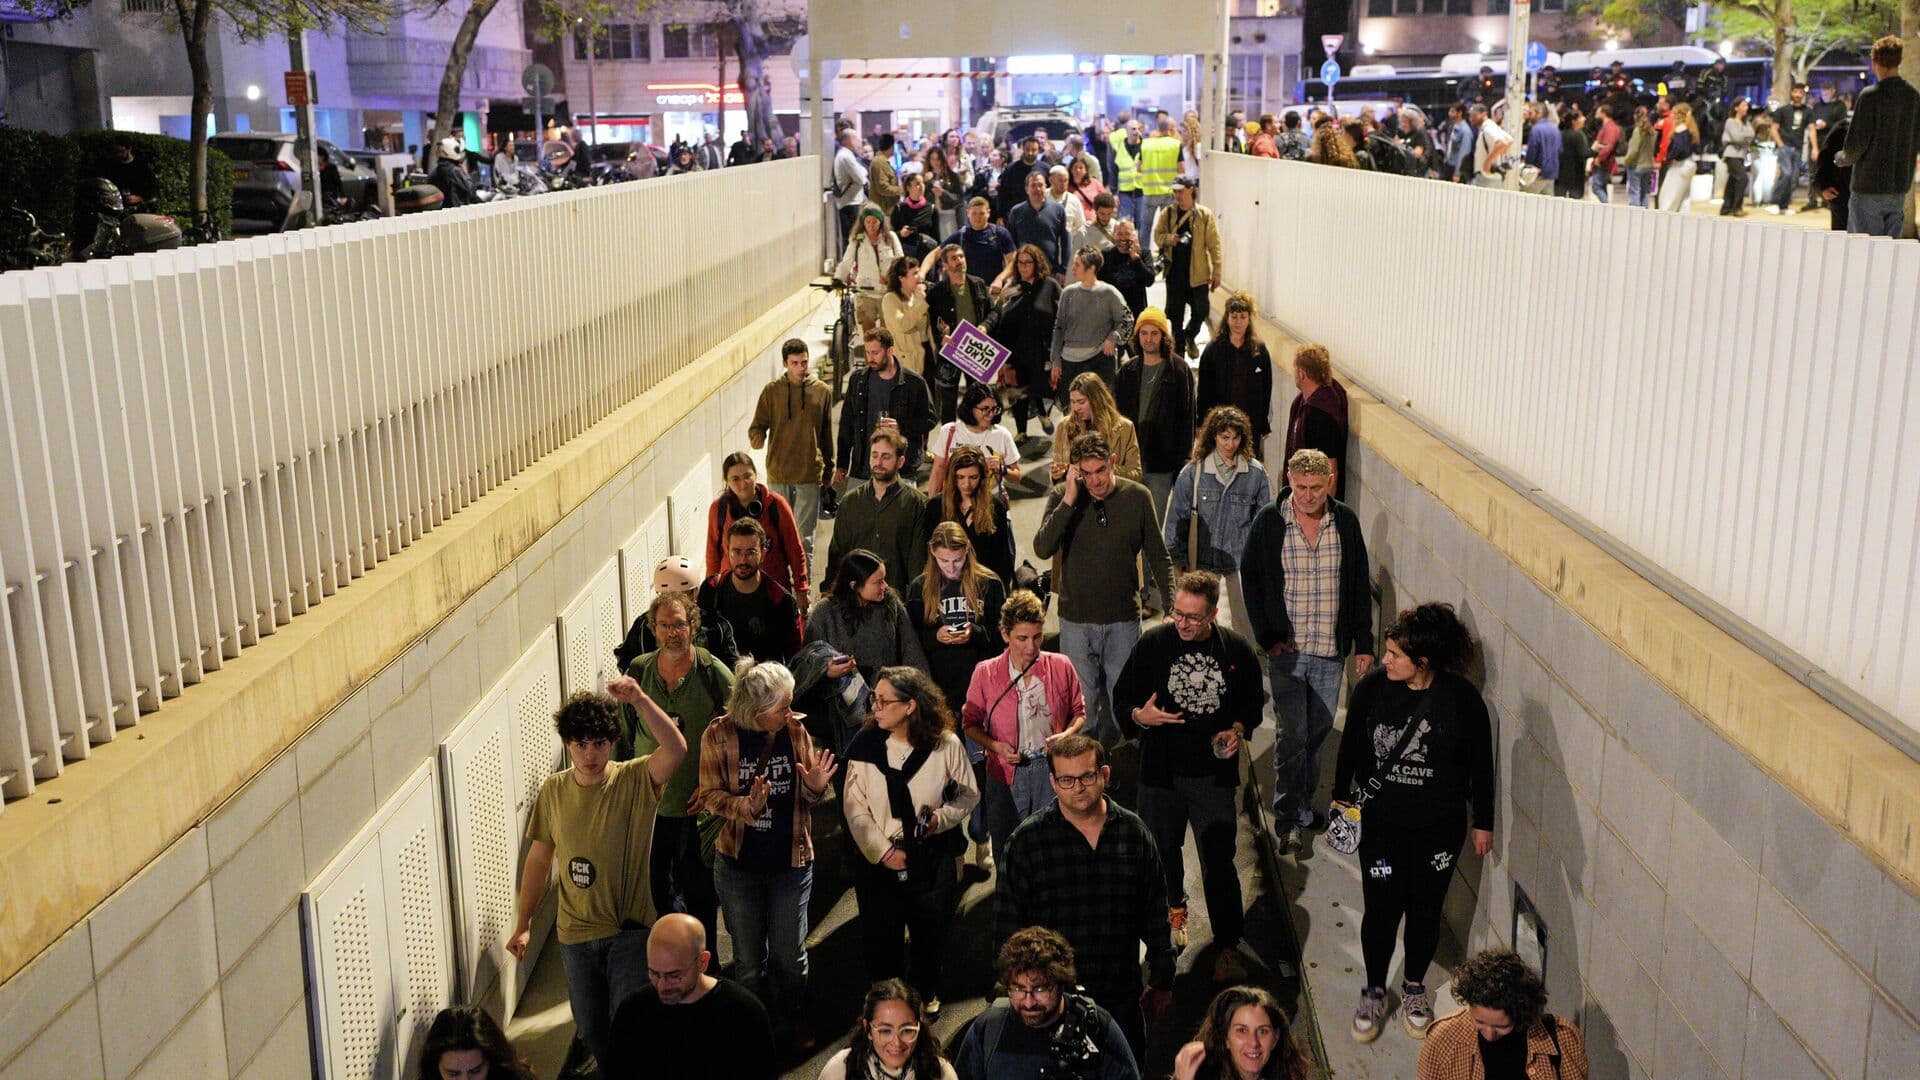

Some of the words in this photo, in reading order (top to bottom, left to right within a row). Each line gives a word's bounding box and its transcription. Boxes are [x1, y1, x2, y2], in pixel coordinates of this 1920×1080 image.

[1402, 765, 1434, 777] CAVE
[1385, 773, 1396, 782] AD
[1397, 776, 1423, 786] SEEDS
[572, 861, 590, 875] FCK
[572, 872, 590, 885] WAR
